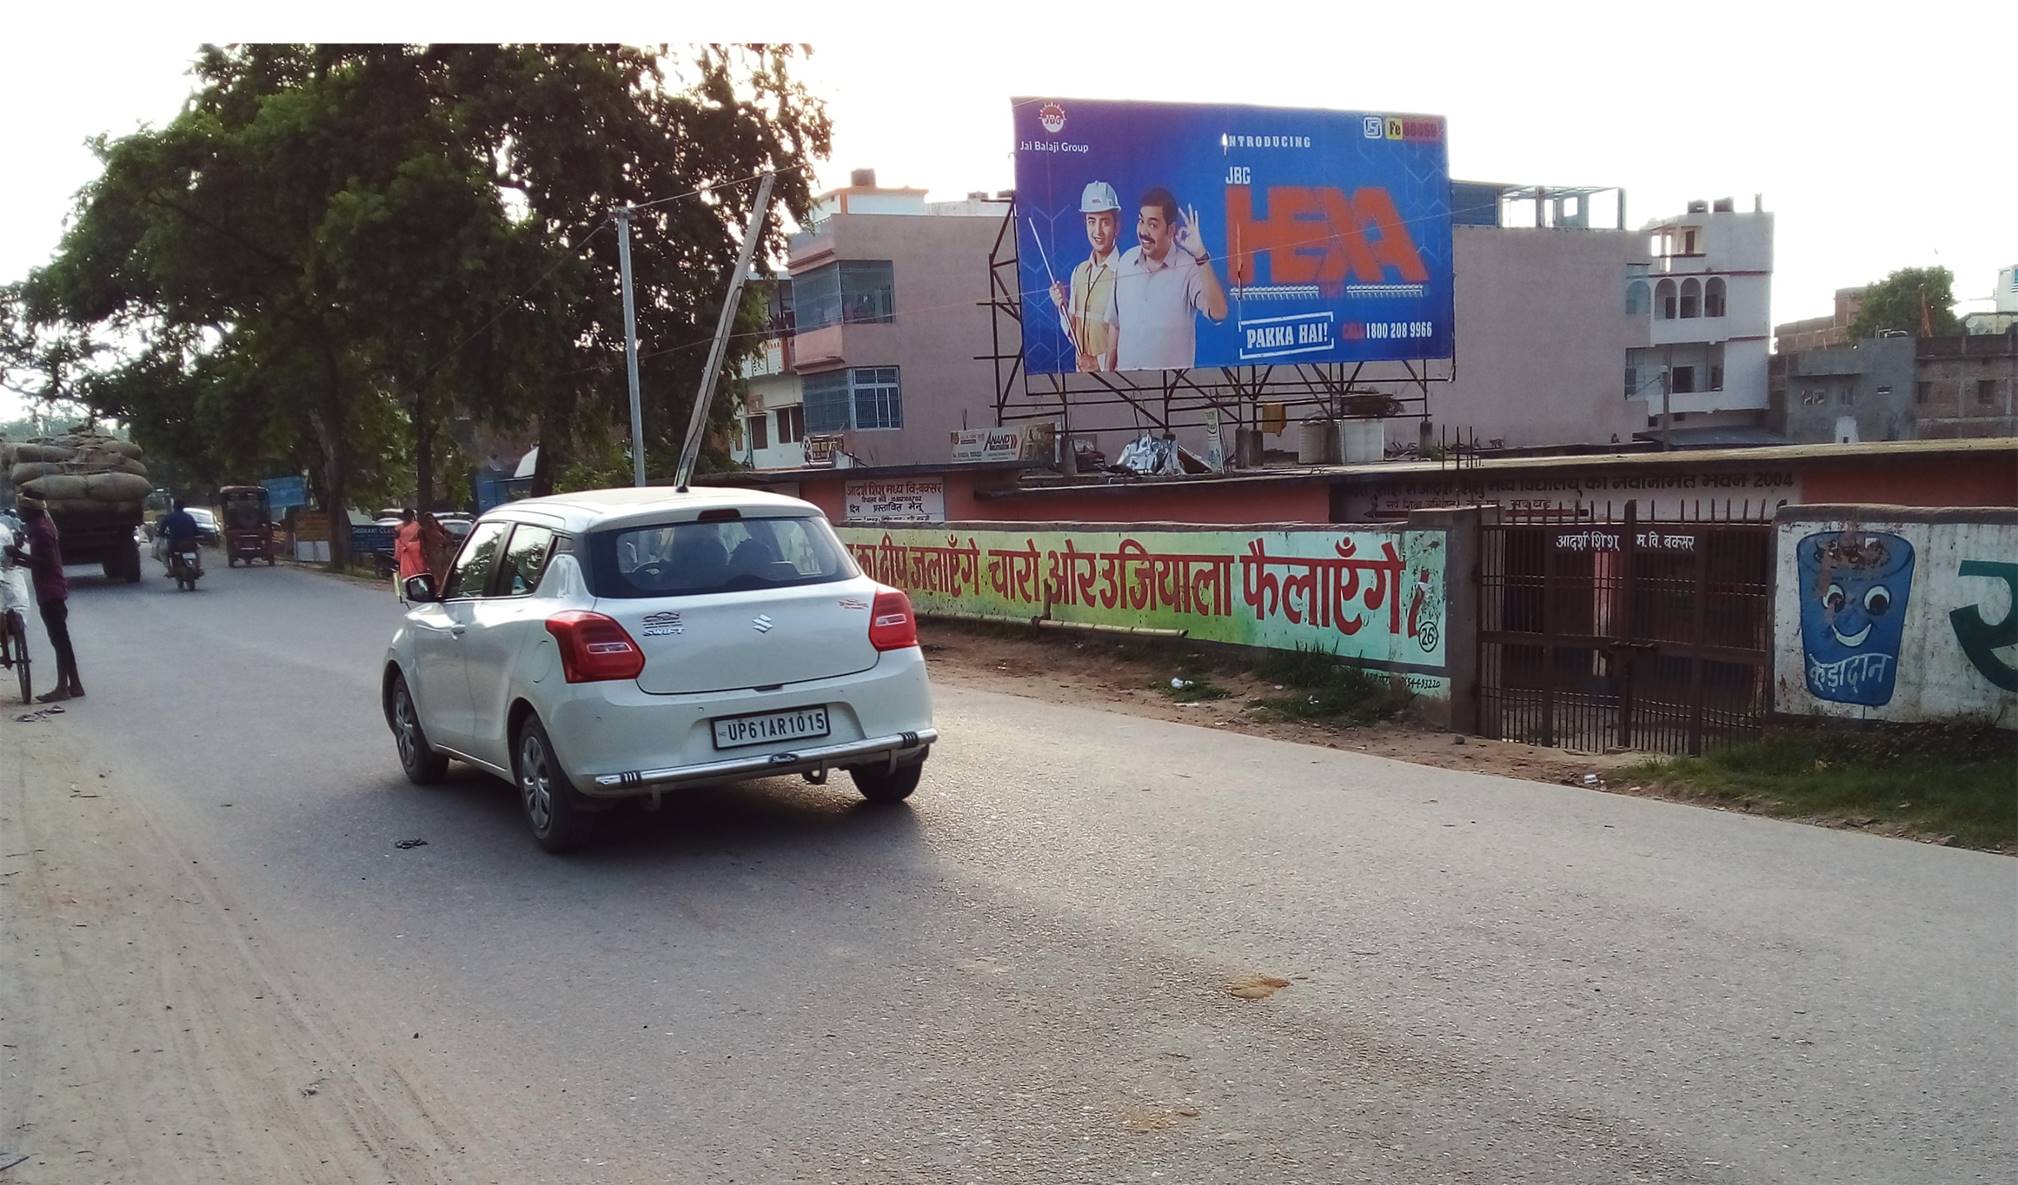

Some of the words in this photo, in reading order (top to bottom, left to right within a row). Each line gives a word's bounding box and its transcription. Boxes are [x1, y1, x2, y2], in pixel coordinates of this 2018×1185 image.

[1034, 141, 1059, 153] Balaji
[1061, 142, 1089, 153] Group
[1221, 134, 1311, 148] NTRODUCING
[1225, 166, 1250, 184] JBG
[1225, 186, 1430, 284] HEXA
[1246, 325, 1294, 349] PAKKA
[1298, 322, 1328, 344] HAI!
[1366, 322, 1387, 339] 1800
[1390, 321, 1407, 339] 208
[1410, 321, 1433, 338] 9966
[1702, 472, 1748, 489] भवन
[1753, 471, 1793, 488] 2004
[873, 501, 903, 513] प्रस्तावित
[1556, 531, 1590, 551] आदर्श
[1663, 534, 1695, 552] बक्सर
[910, 534, 981, 598] जलाएँगे
[988, 538, 1042, 604] चारो
[1048, 538, 1097, 608] ओर
[1099, 538, 1235, 618] उजियाला
[643, 626, 687, 637] SWIFT
[1421, 626, 1435, 646] 26
[727, 712, 825, 741] UP61AR1015
